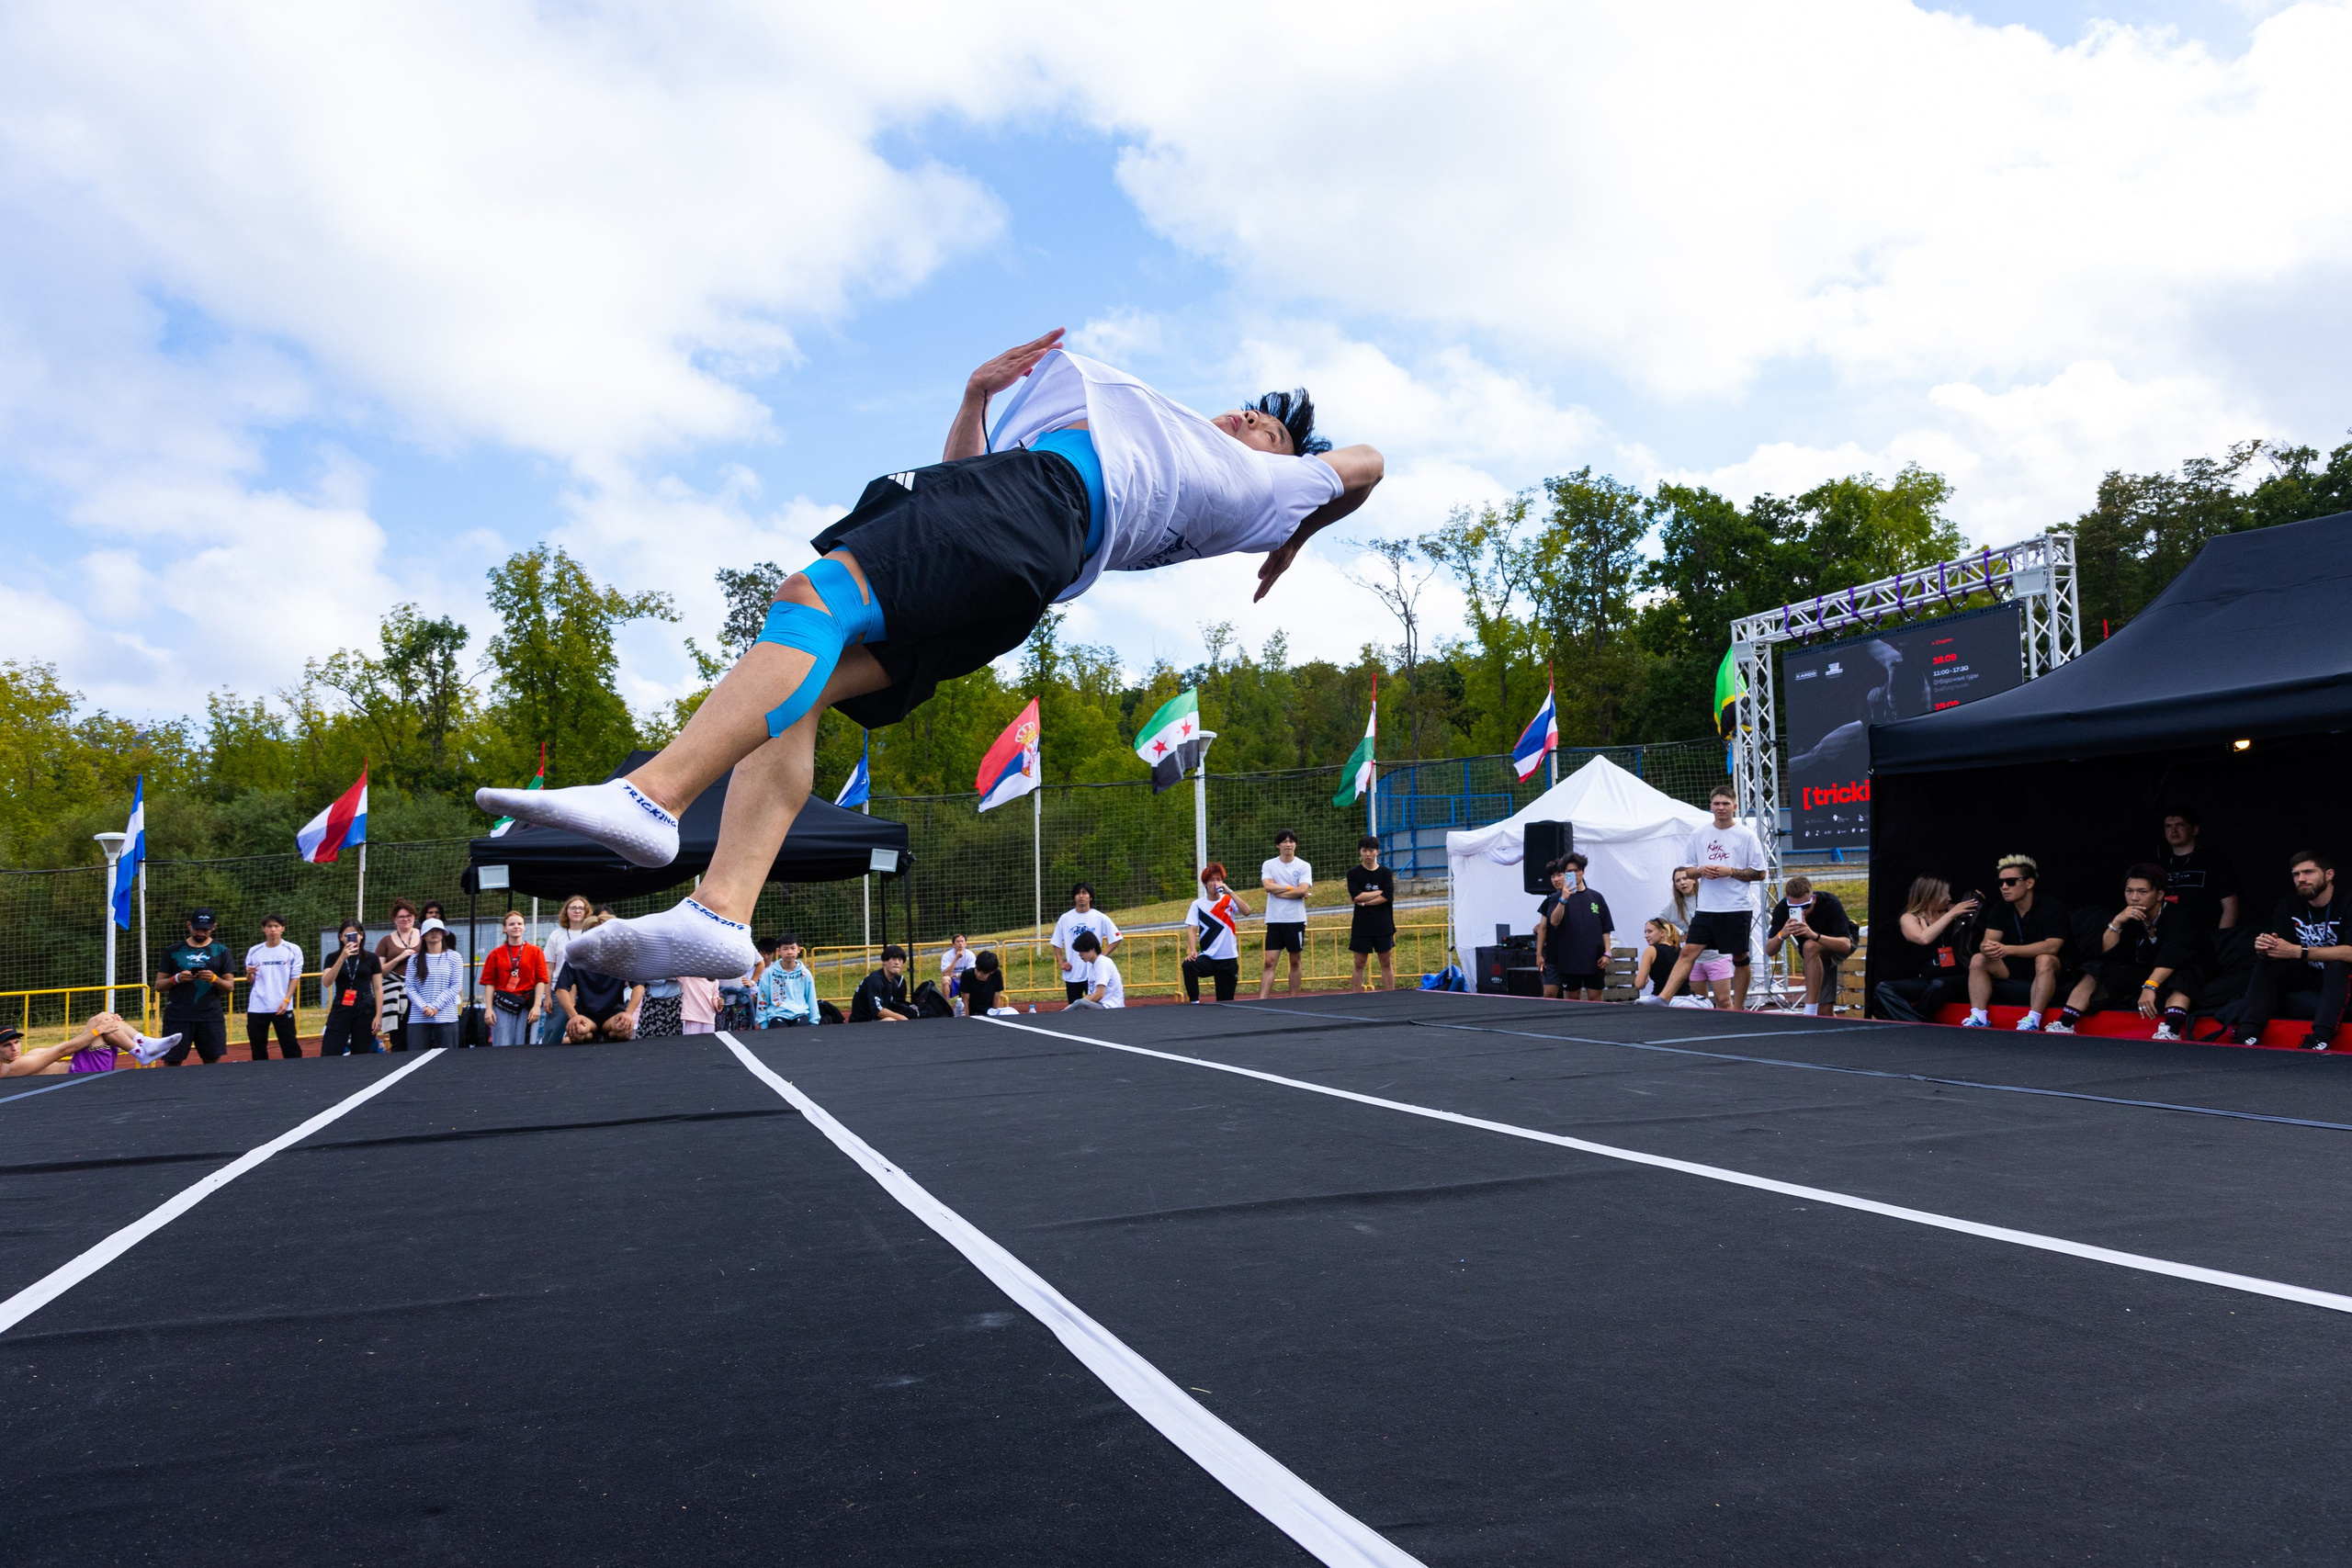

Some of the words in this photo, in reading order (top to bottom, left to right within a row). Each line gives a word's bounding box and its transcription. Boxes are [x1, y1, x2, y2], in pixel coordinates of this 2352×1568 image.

[1933, 653, 1957, 665] 18.09
[624, 784, 677, 828] TRICKING
[686, 898, 745, 931] TRICKING
